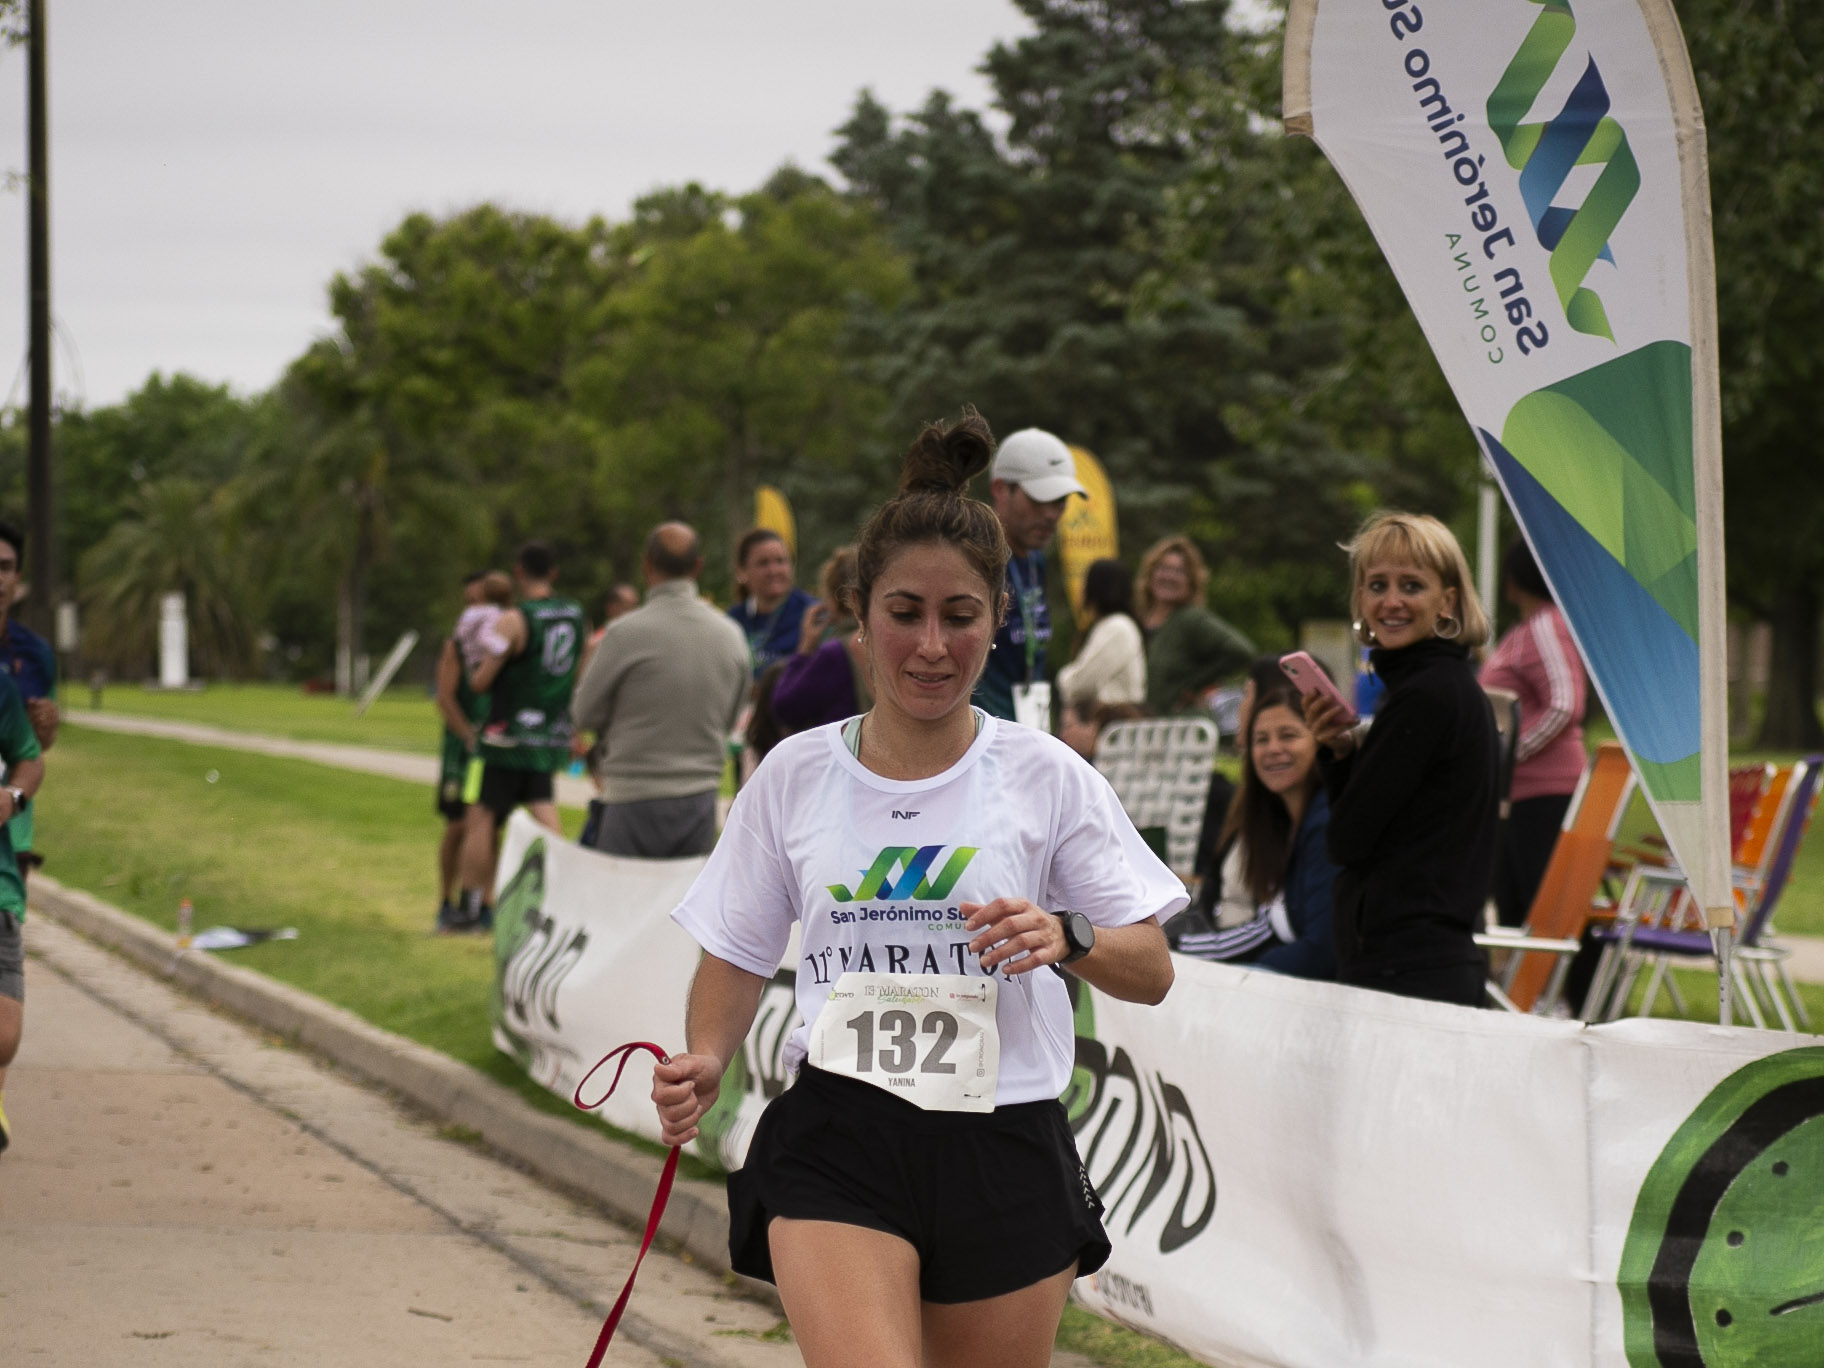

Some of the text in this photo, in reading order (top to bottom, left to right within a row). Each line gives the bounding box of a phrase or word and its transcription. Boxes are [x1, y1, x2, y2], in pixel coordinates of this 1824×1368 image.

[830, 905, 969, 925] San Jerónimo Su
[927, 922, 967, 931] COMU
[838, 942, 1023, 985] MARATO
[846, 1009, 959, 1075] 132
[887, 1077, 916, 1088] YANINA
